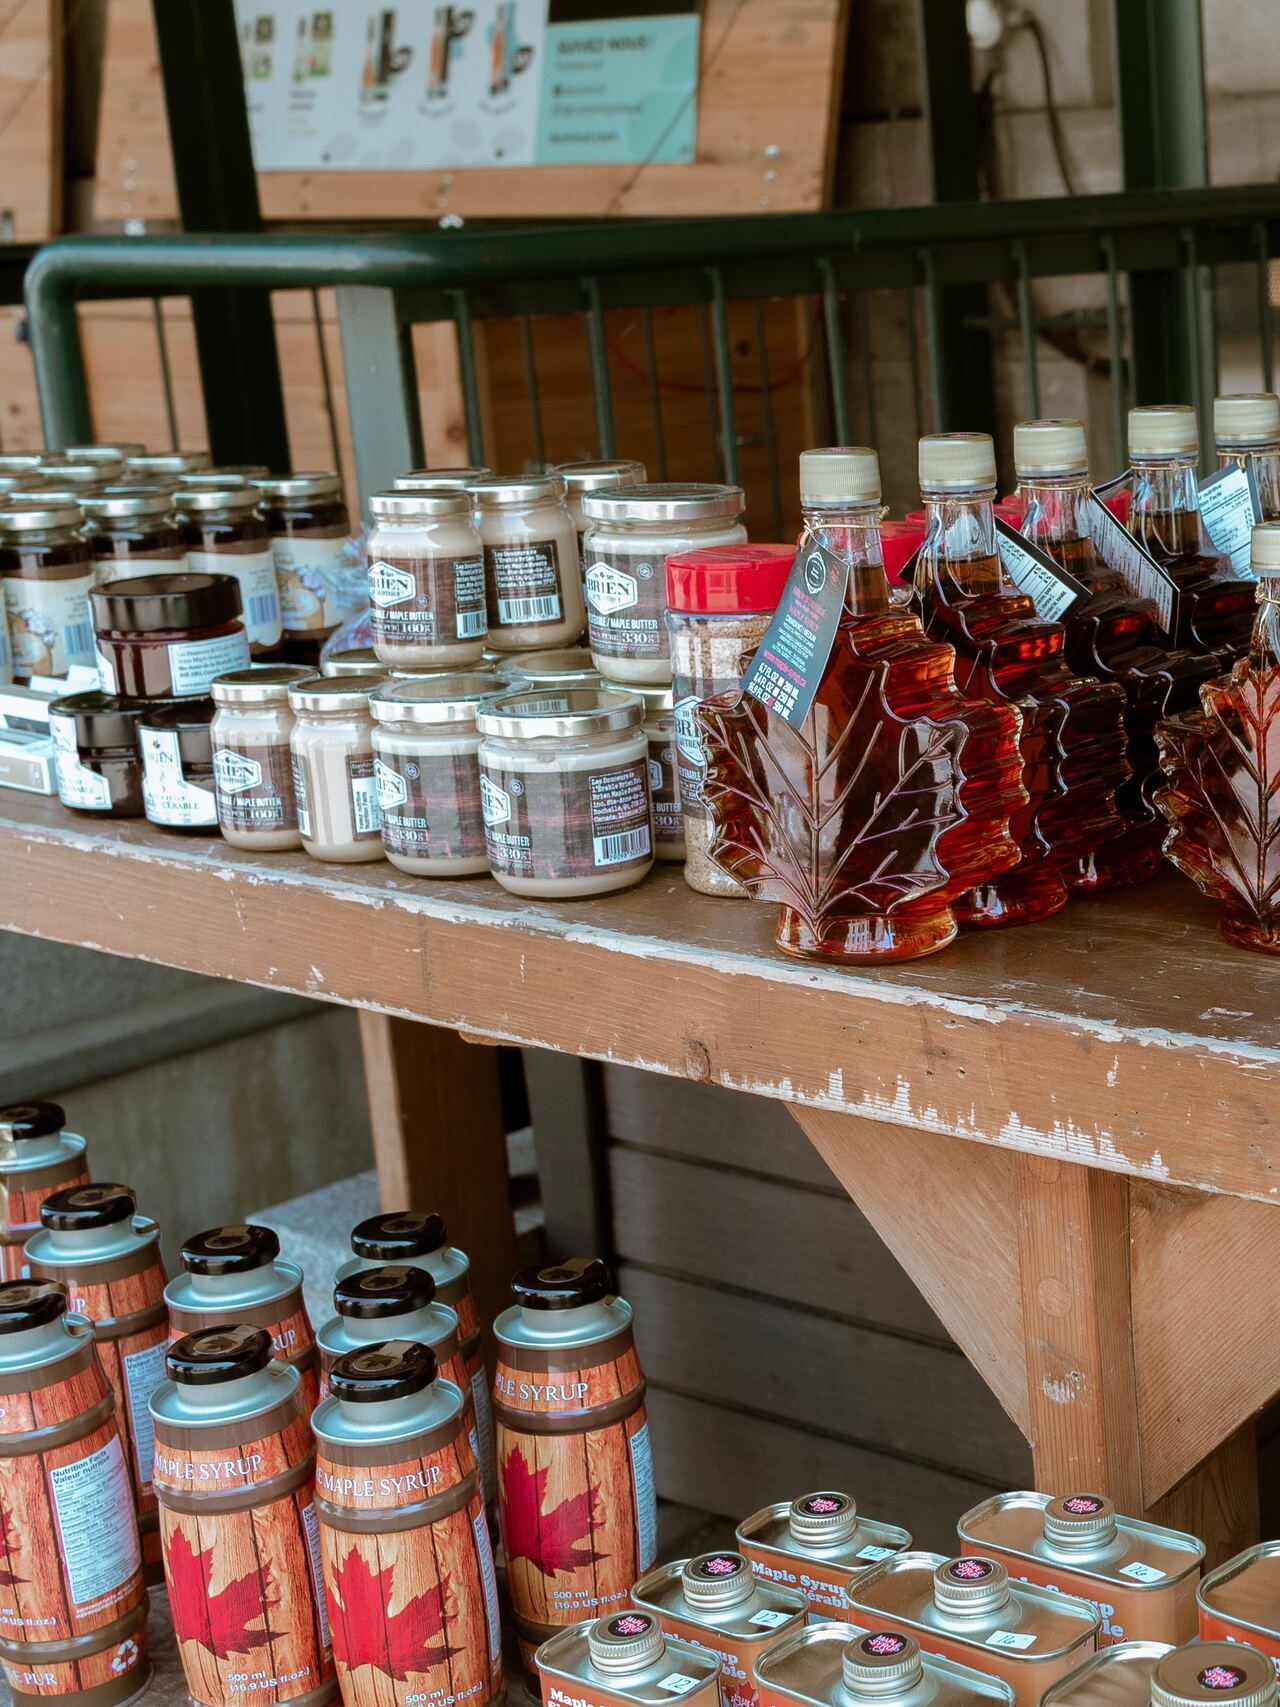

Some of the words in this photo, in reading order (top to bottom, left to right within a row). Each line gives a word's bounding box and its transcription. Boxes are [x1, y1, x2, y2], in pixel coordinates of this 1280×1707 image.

[588, 578, 630, 596] BRIEN
[409, 611, 434, 620] BUTTER
[610, 617, 631, 629] MAPLE
[631, 619, 658, 629] BUTTER
[403, 816, 427, 827] BUTTER
[655, 815, 680, 825] 30g
[507, 834, 530, 846] BUTTER
[272, 1329, 297, 1351] RUP
[495, 1372, 515, 1397] PLE
[519, 1382, 589, 1402] SYRUP
[52, 1460, 88, 1479] Nutrition
[89, 1450, 107, 1466] Facts
[53, 1472, 80, 1485] Valeur
[82, 1456, 111, 1475] nutritive
[155, 1454, 195, 1480] MAPLE
[200, 1454, 263, 1480] SYRUP
[323, 1475, 375, 1498] MAPLE
[380, 1466, 441, 1497] SYRUP
[863, 1547, 887, 1557] 12
[751, 1561, 797, 1584] Maple
[800, 1575, 848, 1598] Syrup
[553, 1590, 572, 1599] 500
[575, 1590, 589, 1598] ml
[554, 1600, 580, 1609] (16.9
[583, 1598, 598, 1607] US
[601, 1589, 628, 1604] fl.oz.)
[798, 1588, 849, 1609] 'érabl
[10, 1617, 24, 1626] US
[760, 1612, 778, 1624] 12
[23, 1672, 57, 1686] PUR
[227, 1671, 248, 1682] 500
[251, 1670, 266, 1680] ml
[230, 1682, 257, 1693] (16.9
[260, 1679, 276, 1689] US
[280, 1667, 310, 1684] fl.oz.)
[669, 1678, 691, 1690] 12
[405, 1693, 426, 1703] 500
[430, 1689, 444, 1699] ml
[438, 1696, 454, 1707] US
[457, 1680, 482, 1701] fl.oz.)
[550, 1687, 593, 1707] Mapl
